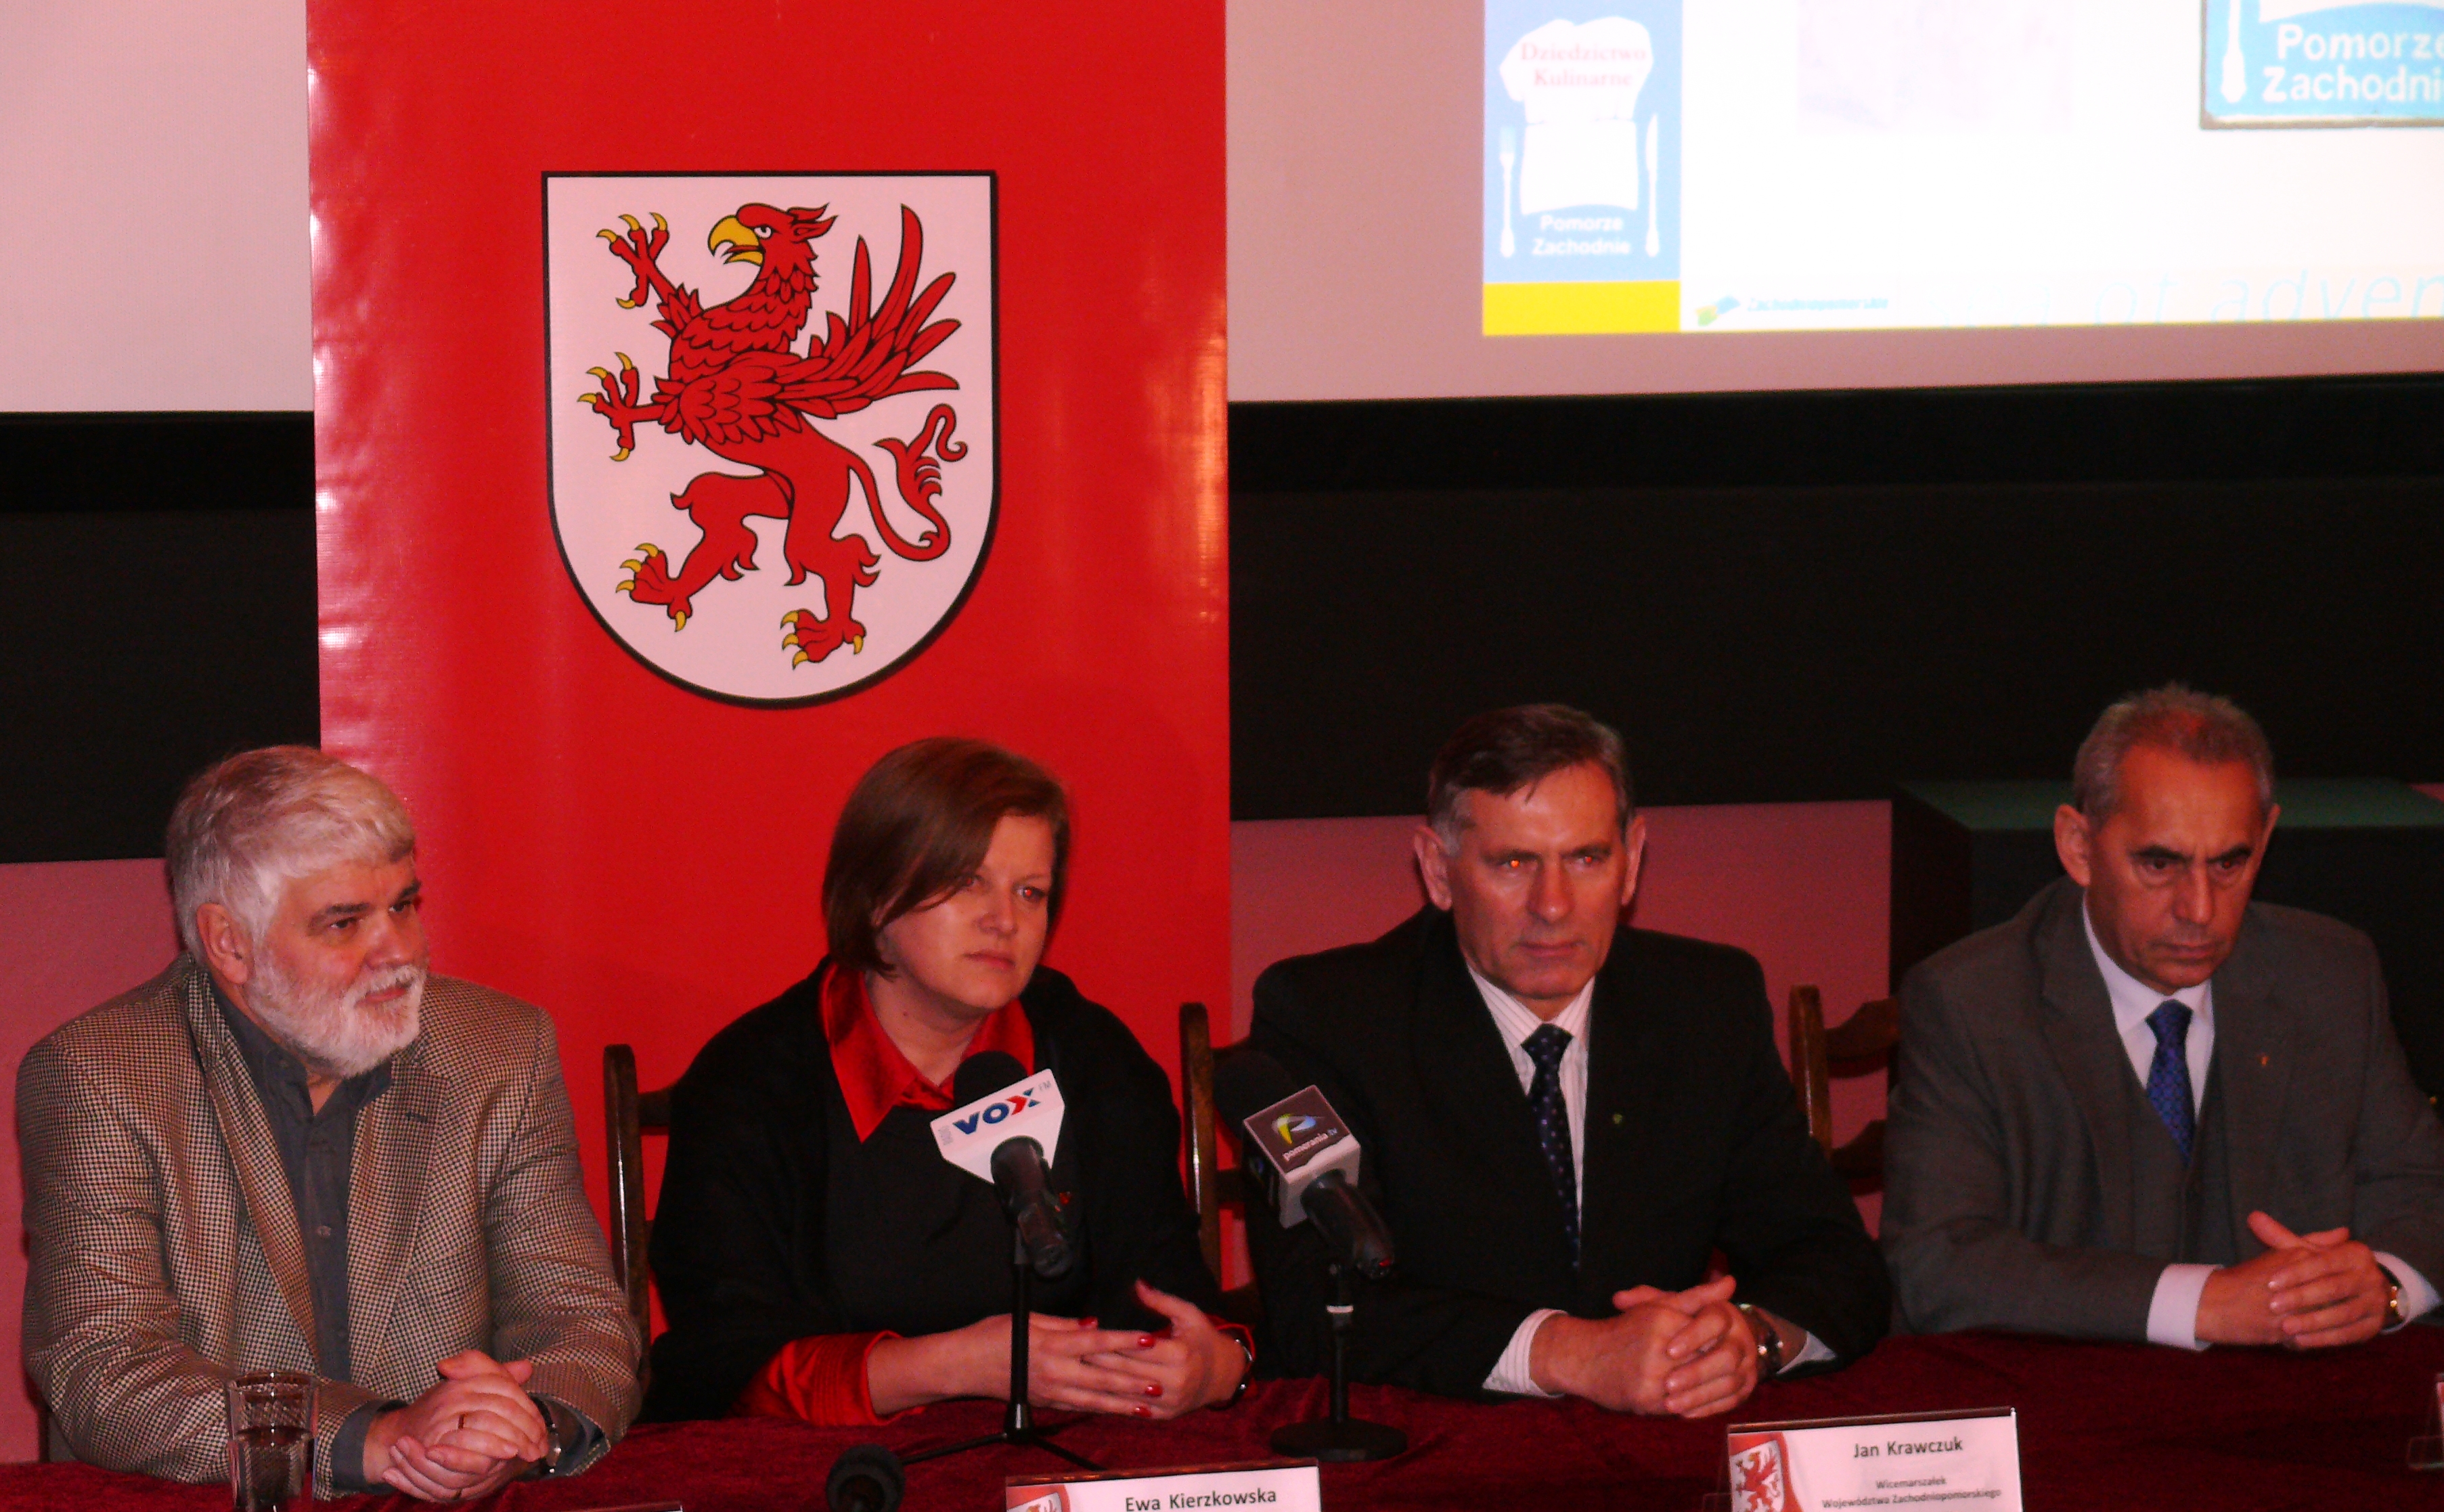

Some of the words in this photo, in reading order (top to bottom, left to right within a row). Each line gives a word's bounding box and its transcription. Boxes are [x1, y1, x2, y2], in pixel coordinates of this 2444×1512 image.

[1521, 43, 1646, 60] Dziedzictwo
[1533, 68, 1632, 85] Kulinarne
[1540, 215, 1623, 231] Pomorze
[1532, 238, 1630, 254] Zachodnie
[952, 1088, 1041, 1134] VOX
[1854, 1444, 1880, 1458] Jan
[1887, 1436, 1963, 1455] Krawczuk
[1126, 1497, 1161, 1512] Ewa
[1169, 1488, 1276, 1509] Kierzkowska
